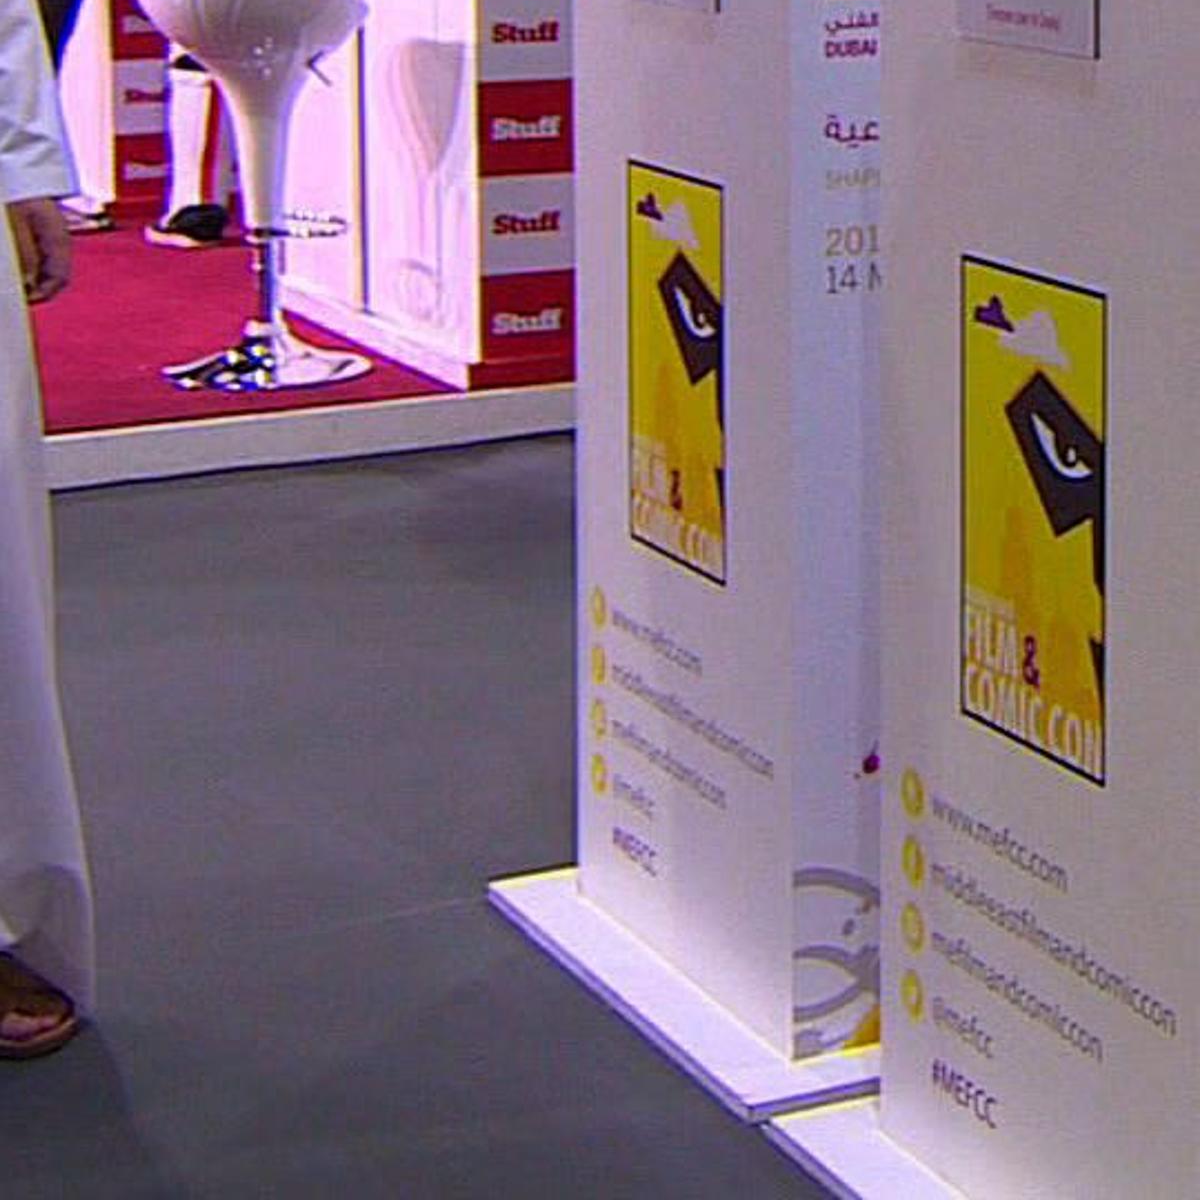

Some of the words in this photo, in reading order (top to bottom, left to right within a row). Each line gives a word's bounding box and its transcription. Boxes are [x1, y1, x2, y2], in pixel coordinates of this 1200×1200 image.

[492, 21, 559, 43] Stuff
[491, 116, 560, 141] Stuff
[492, 211, 560, 234] Stuff
[827, 264, 858, 293] 14
[492, 308, 562, 335] Stuff
[1022, 636, 1040, 690] &
[1048, 704, 1102, 780] CON
[932, 798, 1068, 893] www.mefcc.com
[932, 1059, 997, 1130] #MEFCC
